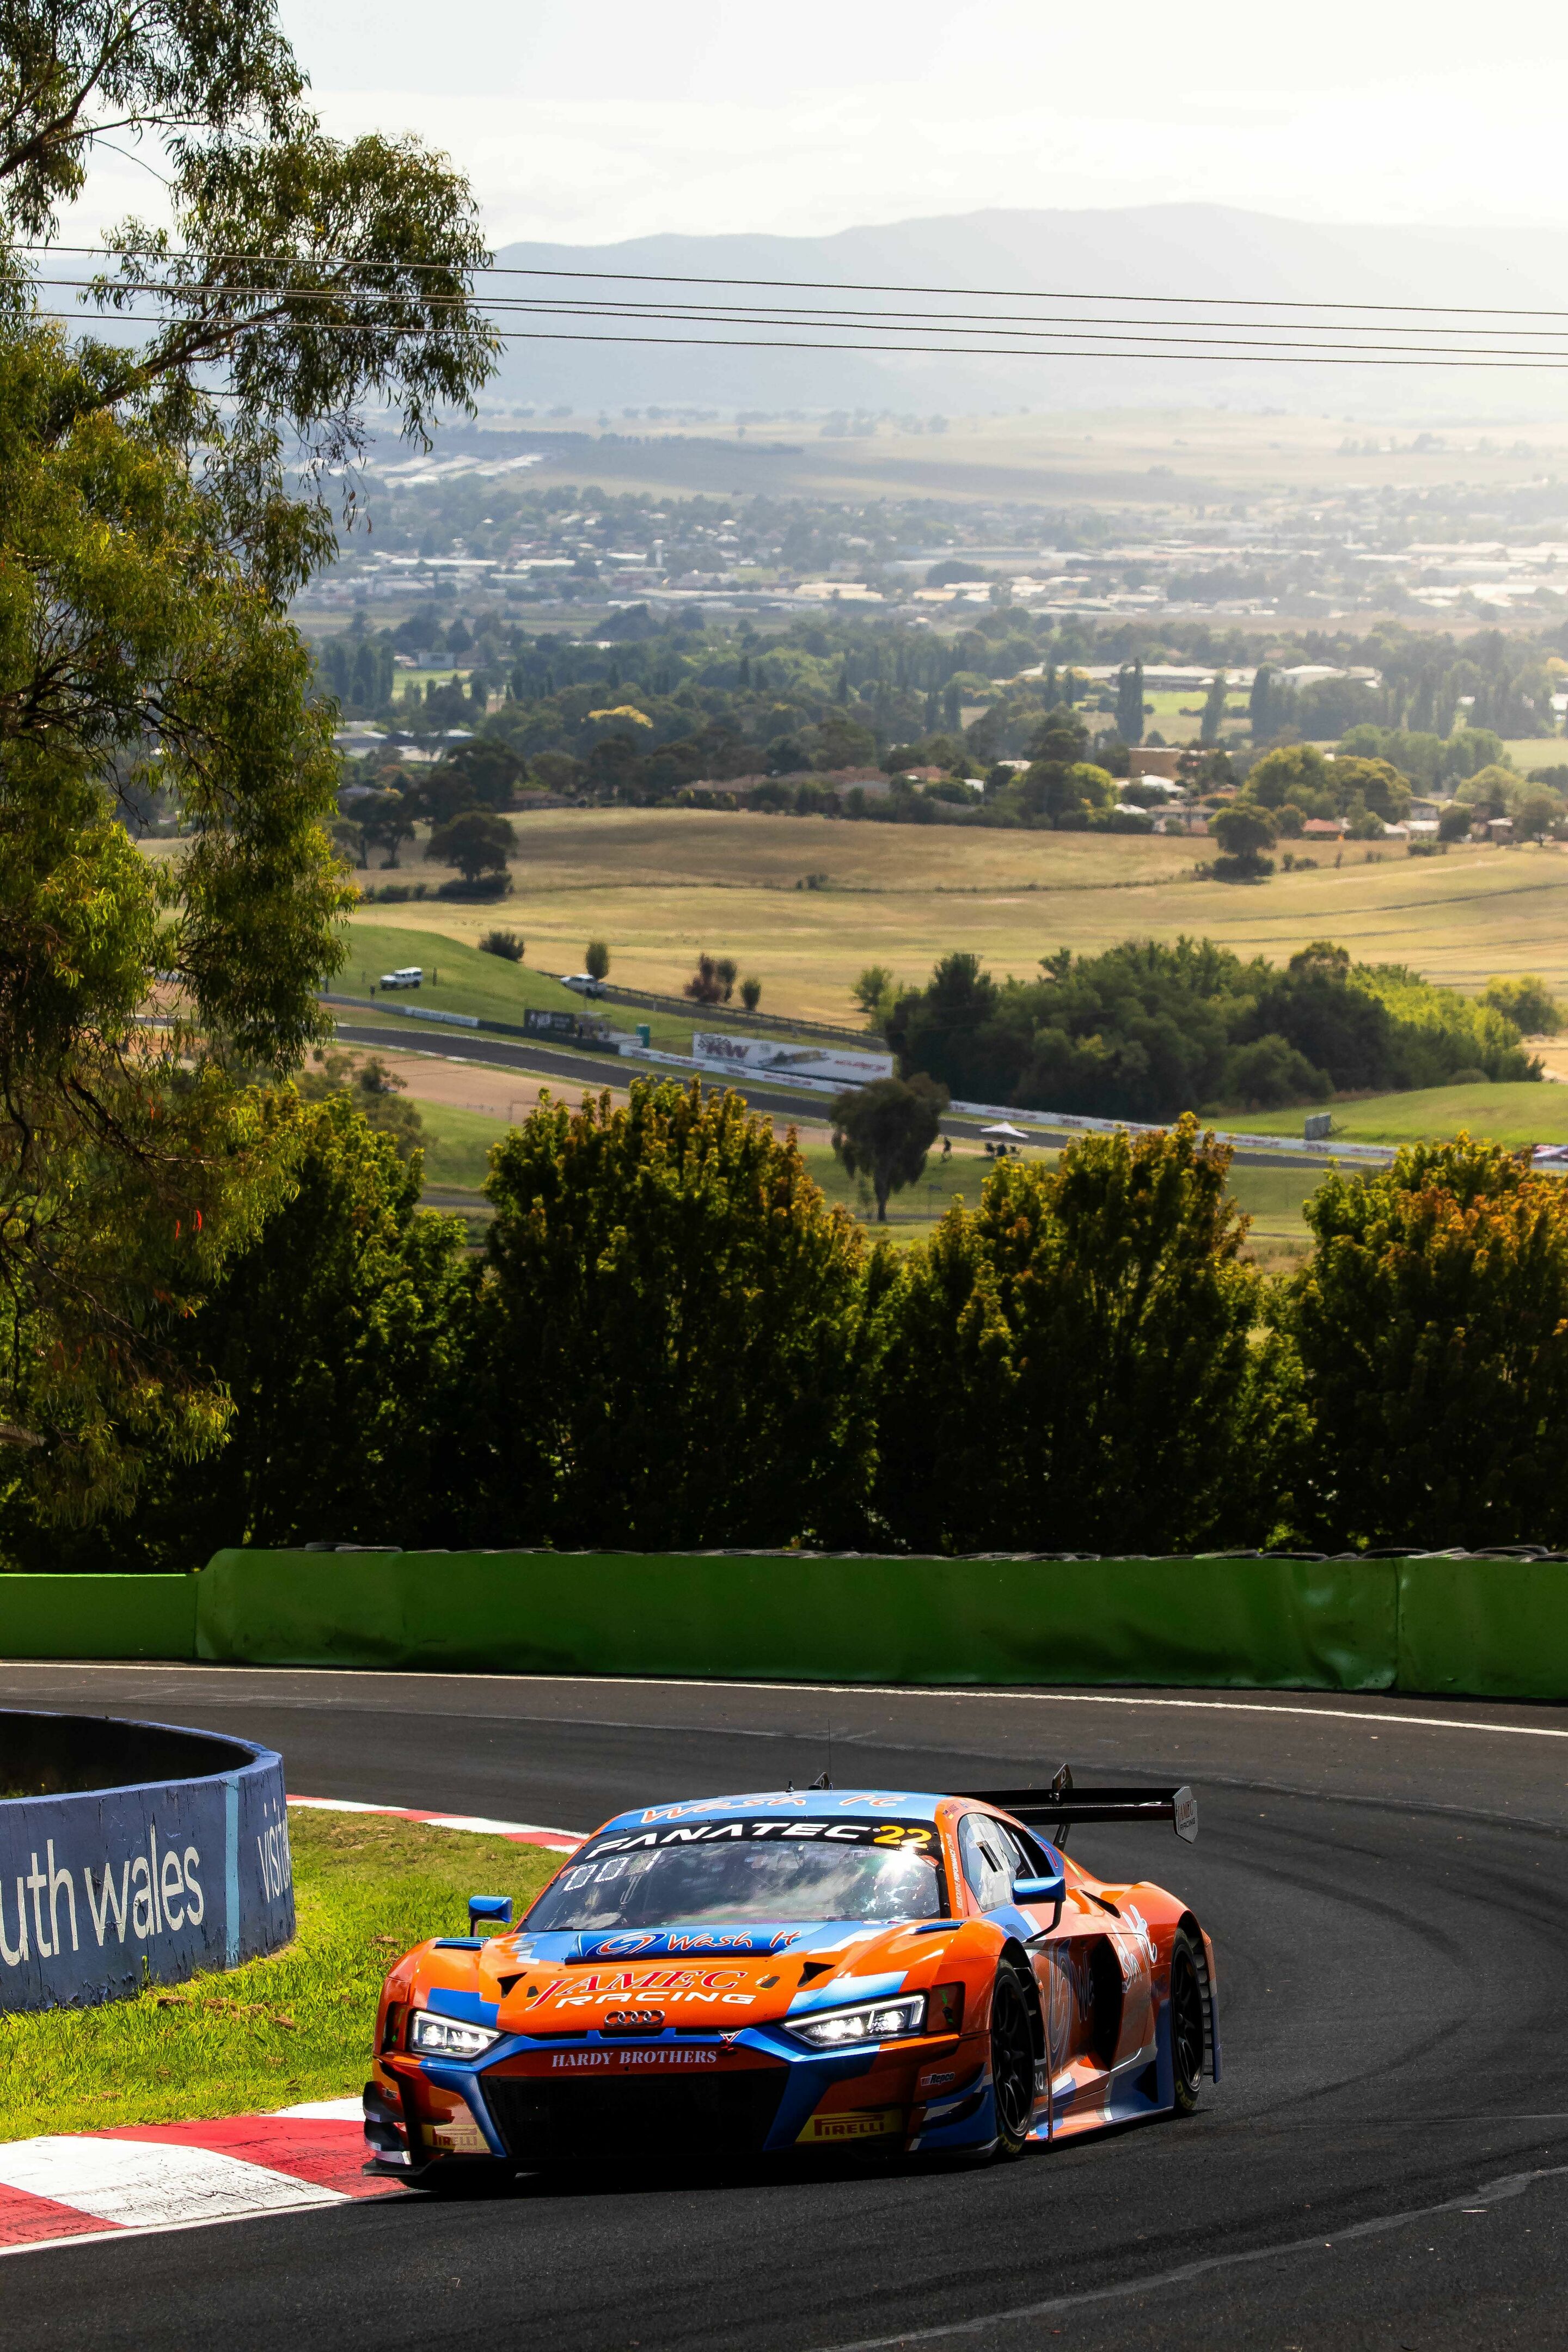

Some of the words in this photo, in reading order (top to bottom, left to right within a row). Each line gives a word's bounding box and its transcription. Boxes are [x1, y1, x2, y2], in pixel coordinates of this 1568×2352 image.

[640, 1793, 807, 1824] Wash
[839, 1794, 908, 1808] It
[1178, 1799, 1194, 1830] JAMEC
[1180, 1817, 1196, 1832] RACING
[585, 1823, 872, 1860] FANATEC
[873, 1825, 933, 1849] 22
[945, 1833, 954, 1848] CENTRE
[950, 1848, 960, 1882] PERFORMANCE
[84, 1824, 205, 1946] wales
[955, 1882, 963, 1910] MELBOURNE
[667, 1930, 753, 1951] Wash
[770, 1930, 801, 1947] It
[525, 1970, 749, 2011] JAMEC
[554, 1991, 757, 2009] RACING
[552, 2052, 614, 2067] HARDY
[619, 2050, 717, 2064] BROTHERS
[930, 2072, 955, 2085] Repco
[432, 2128, 477, 2146] PIRELLI
[814, 2114, 885, 2137] PIRELLI
